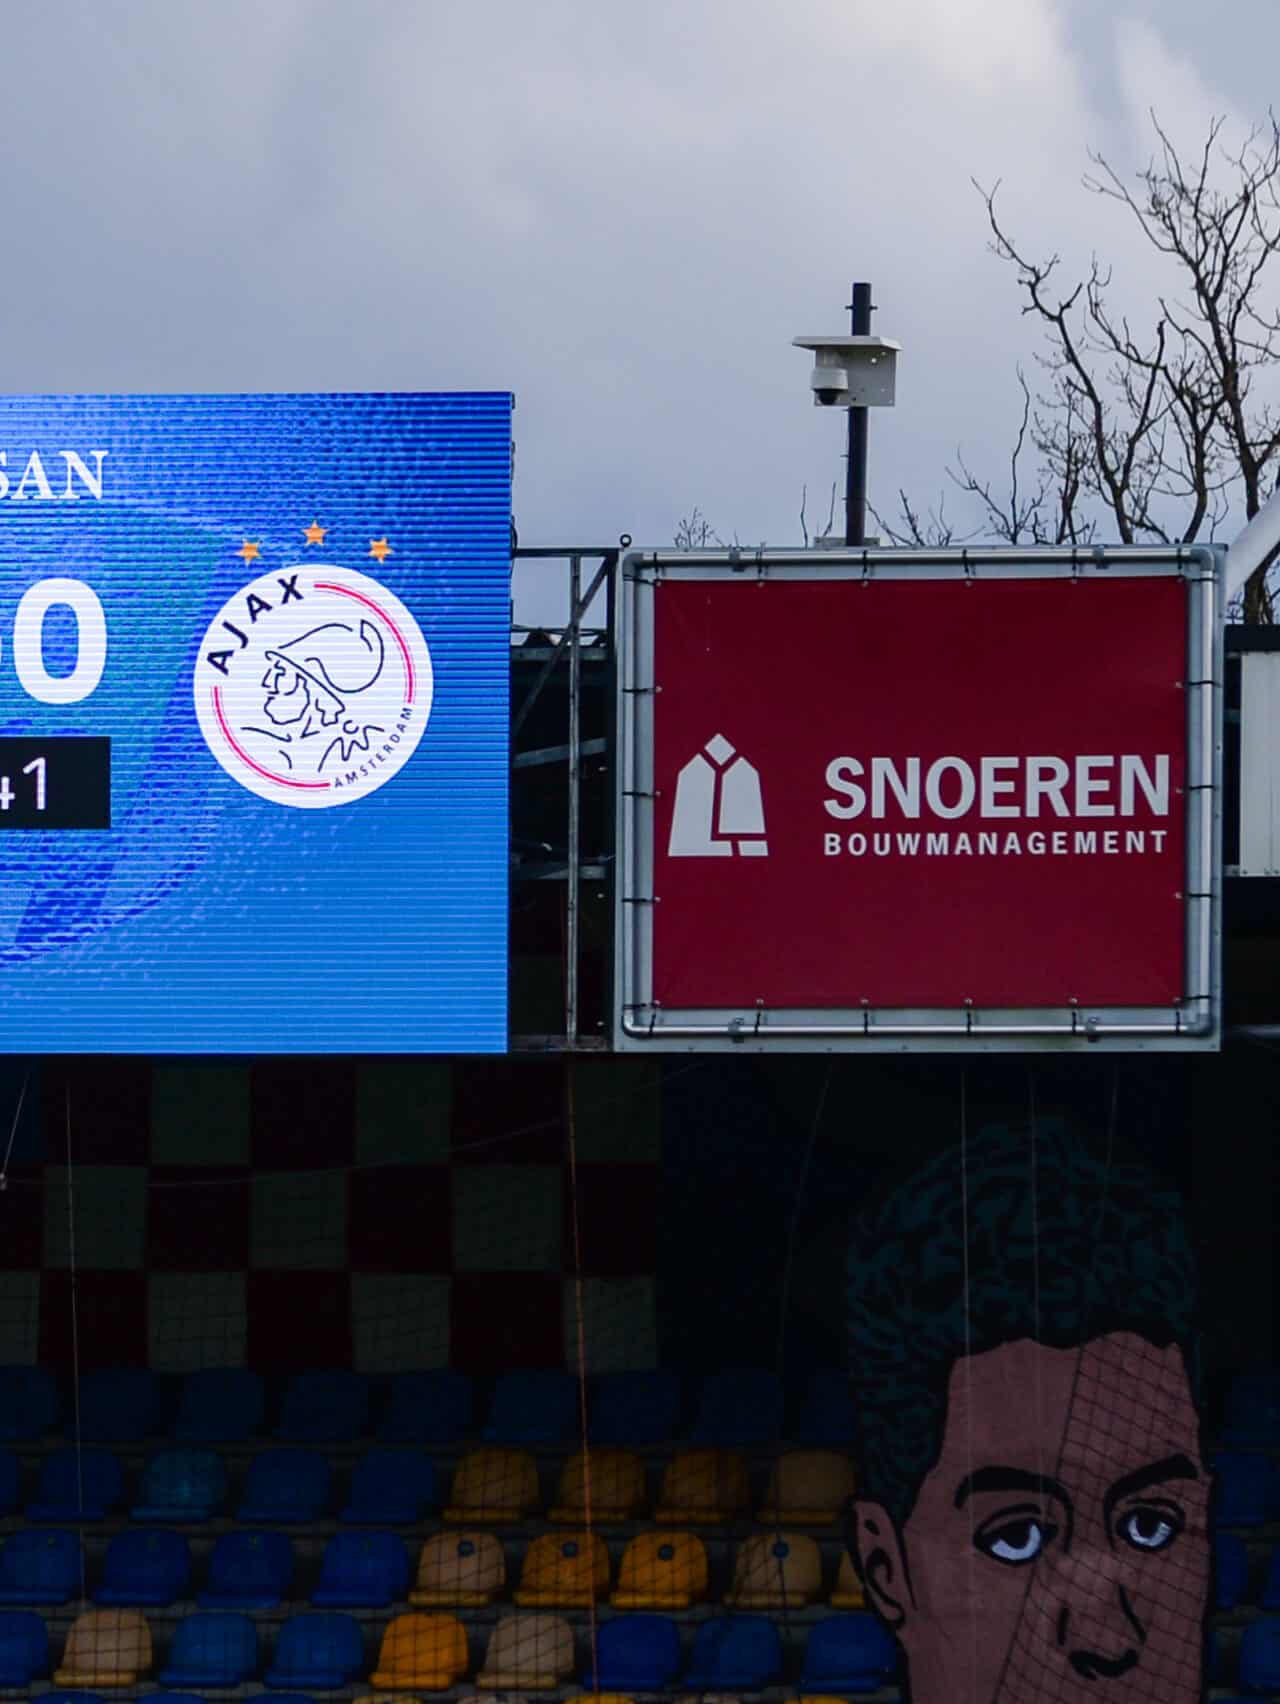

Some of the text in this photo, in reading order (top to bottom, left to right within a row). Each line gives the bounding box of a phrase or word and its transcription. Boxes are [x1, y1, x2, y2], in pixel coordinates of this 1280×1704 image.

[207, 574, 304, 676] AJAX
[334, 707, 414, 788] AMSTERDAM
[823, 754, 1170, 820] SNOEREN
[824, 830, 1168, 857] BOUWMANAGEMENT
